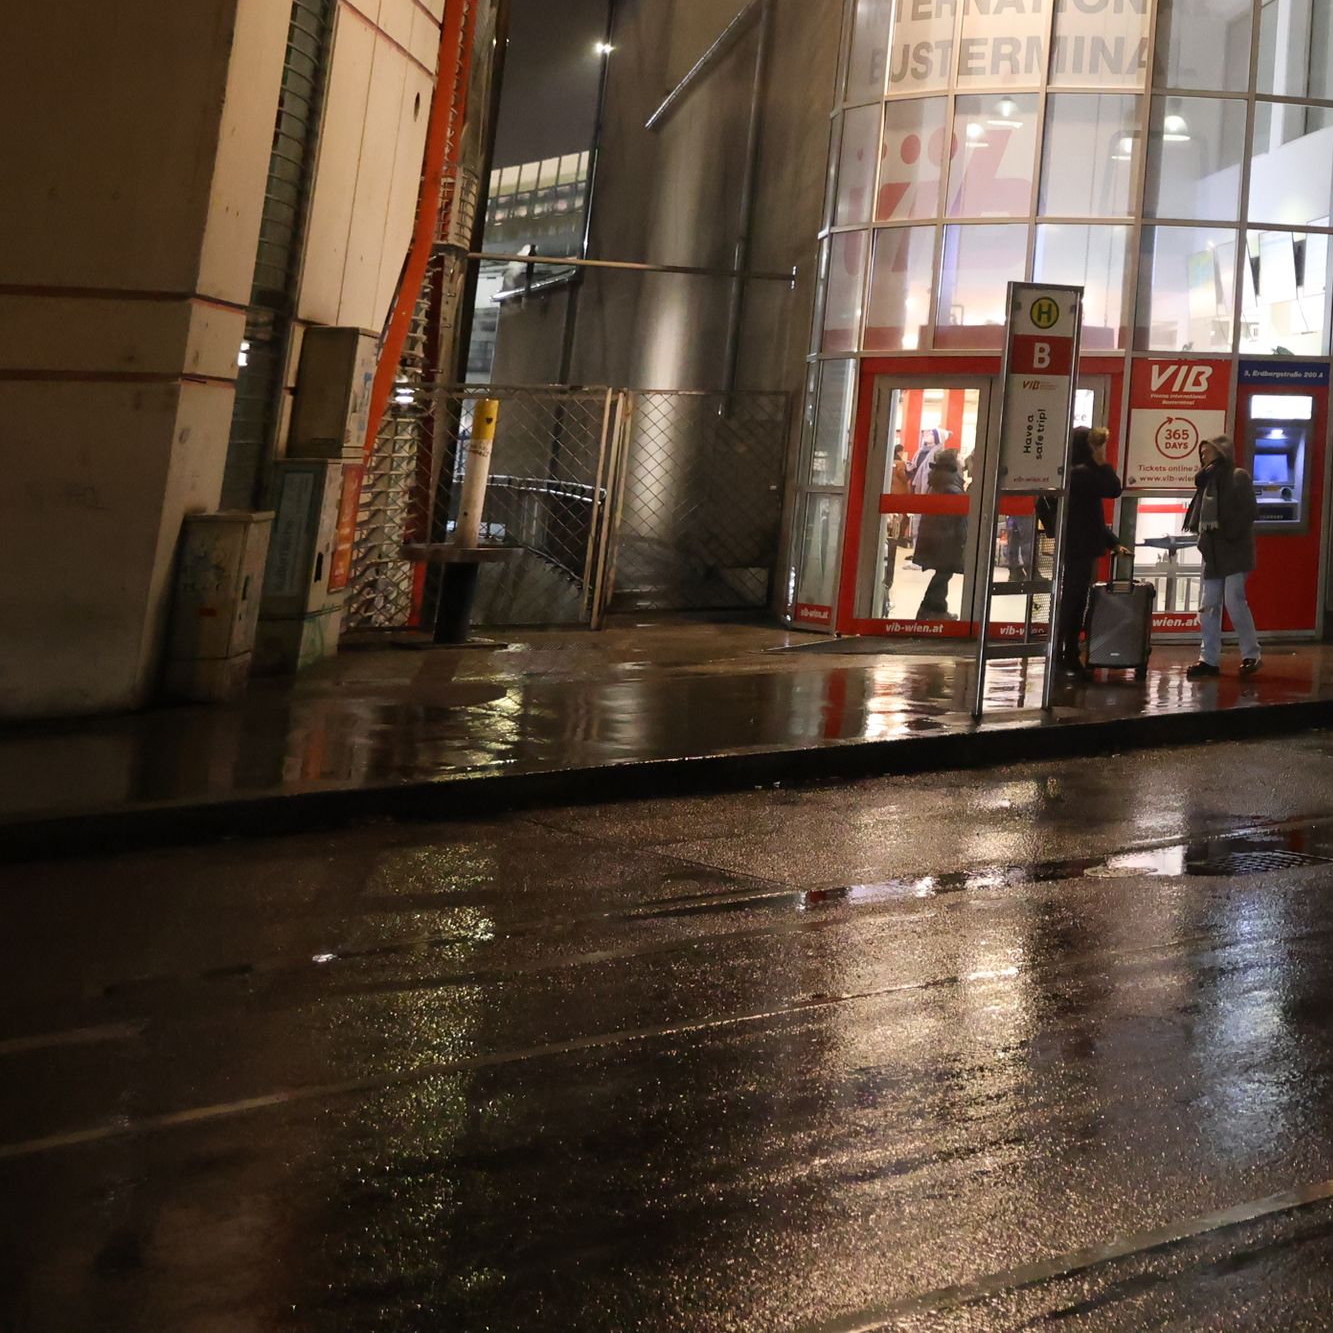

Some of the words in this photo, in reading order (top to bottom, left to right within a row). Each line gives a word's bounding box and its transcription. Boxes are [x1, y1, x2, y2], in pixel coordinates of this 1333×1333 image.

[1038, 303, 1052, 323] H
[1033, 342, 1051, 369] B
[1022, 379, 1040, 391] VIB
[1150, 364, 1213, 393] VIB
[1026, 414, 1034, 423] a
[1037, 409, 1047, 431] trip!
[1023, 426, 1033, 454] Have
[1165, 429, 1190, 440] 365
[1035, 432, 1045, 460] safe
[1165, 442, 1189, 450] DAYS
[1138, 464, 1166, 472] Tickets
[1168, 464, 1192, 472] online
[1152, 615, 1198, 628] wien.at
[885, 623, 944, 634] vib-wien.at
